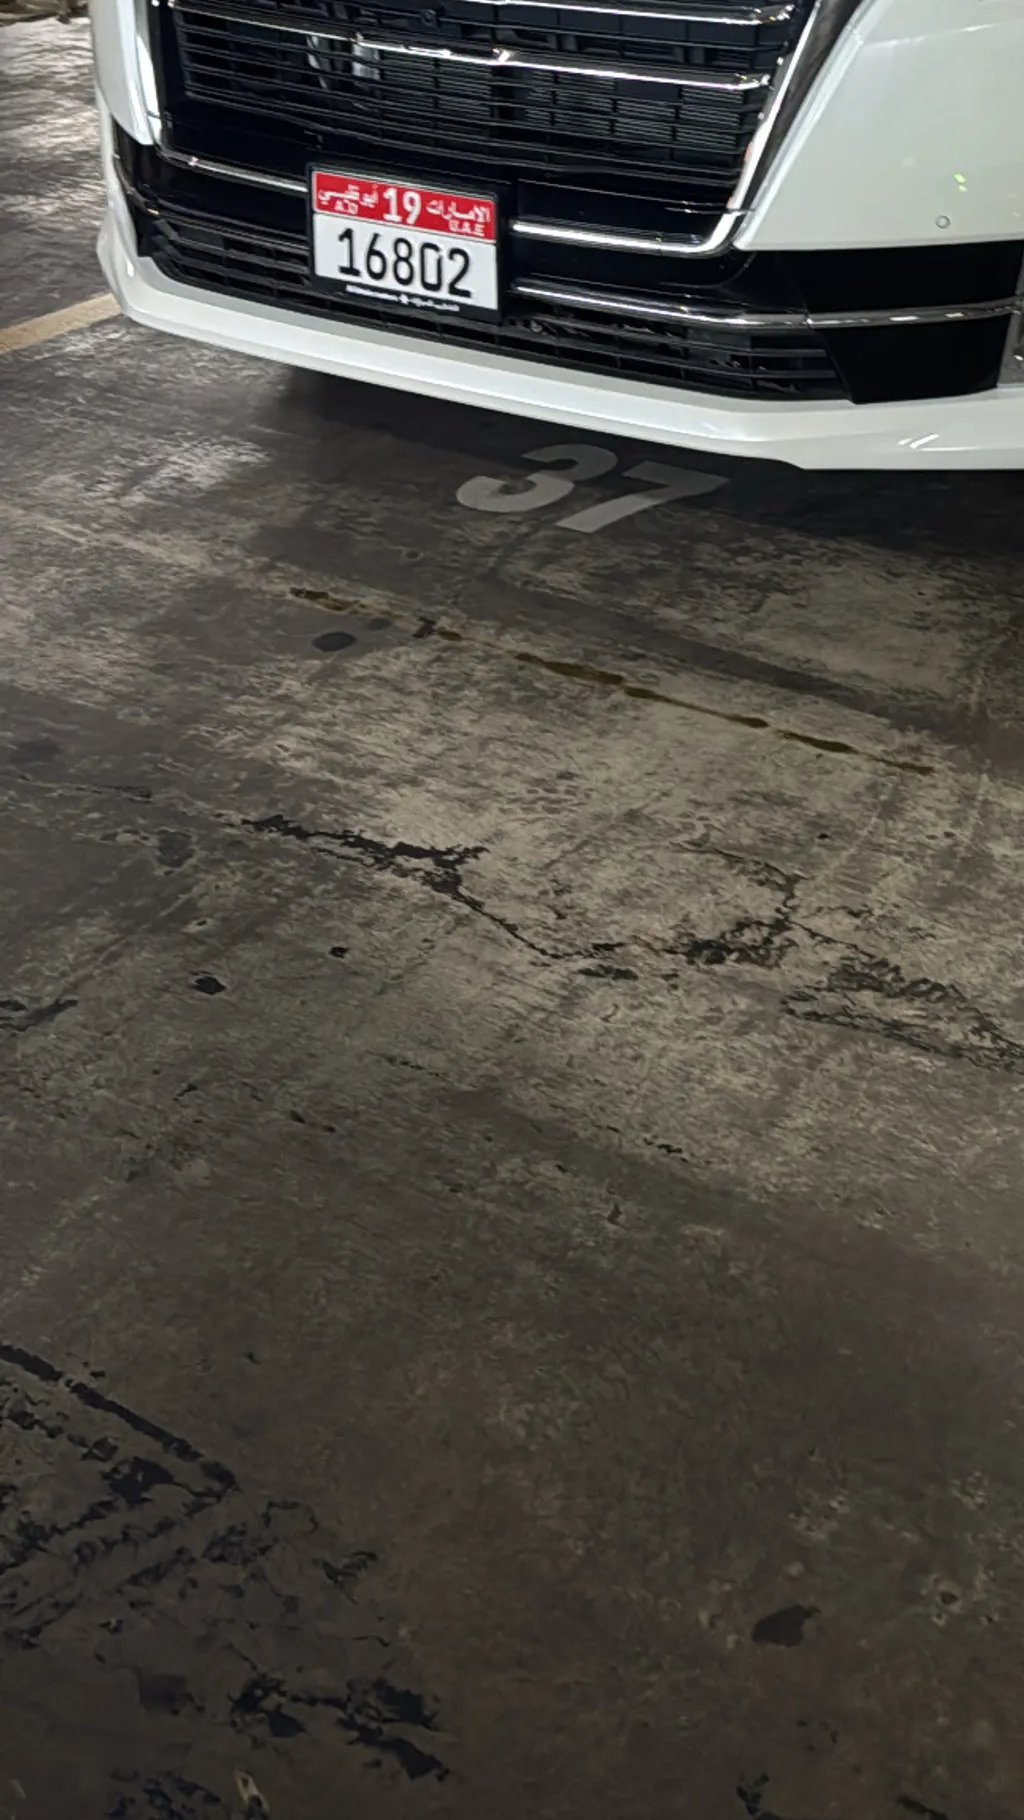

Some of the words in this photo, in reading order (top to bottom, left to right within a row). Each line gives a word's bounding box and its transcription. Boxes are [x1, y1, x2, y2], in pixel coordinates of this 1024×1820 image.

[382, 187, 422, 225] 19
[338, 228, 472, 298] 16802
[456, 443, 730, 533] 37
